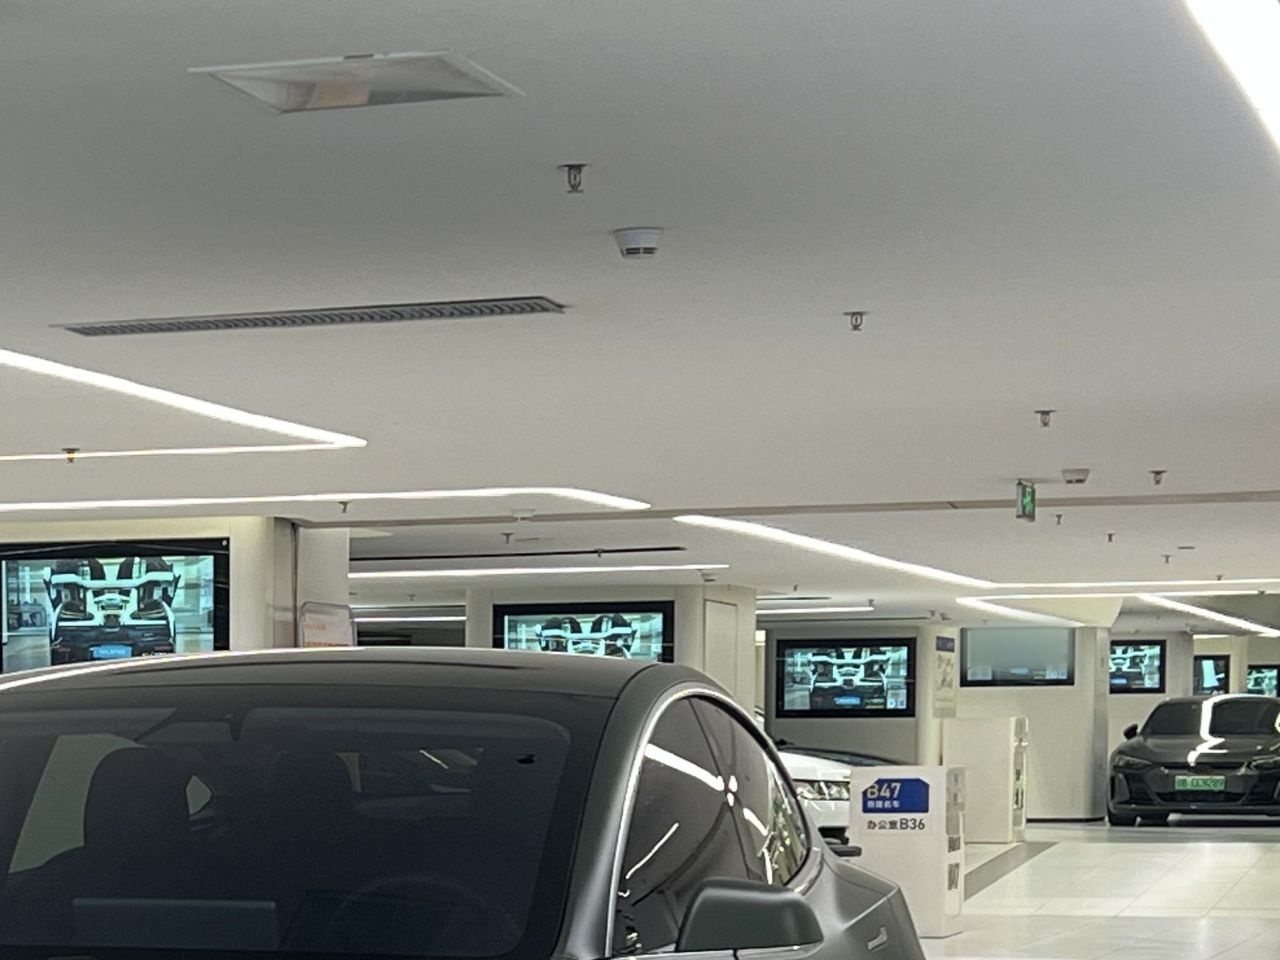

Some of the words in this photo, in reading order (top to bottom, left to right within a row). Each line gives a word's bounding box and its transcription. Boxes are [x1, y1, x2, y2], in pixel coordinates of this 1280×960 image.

[867, 782, 901, 799] B47
[866, 818, 926, 831] 办公室B36
